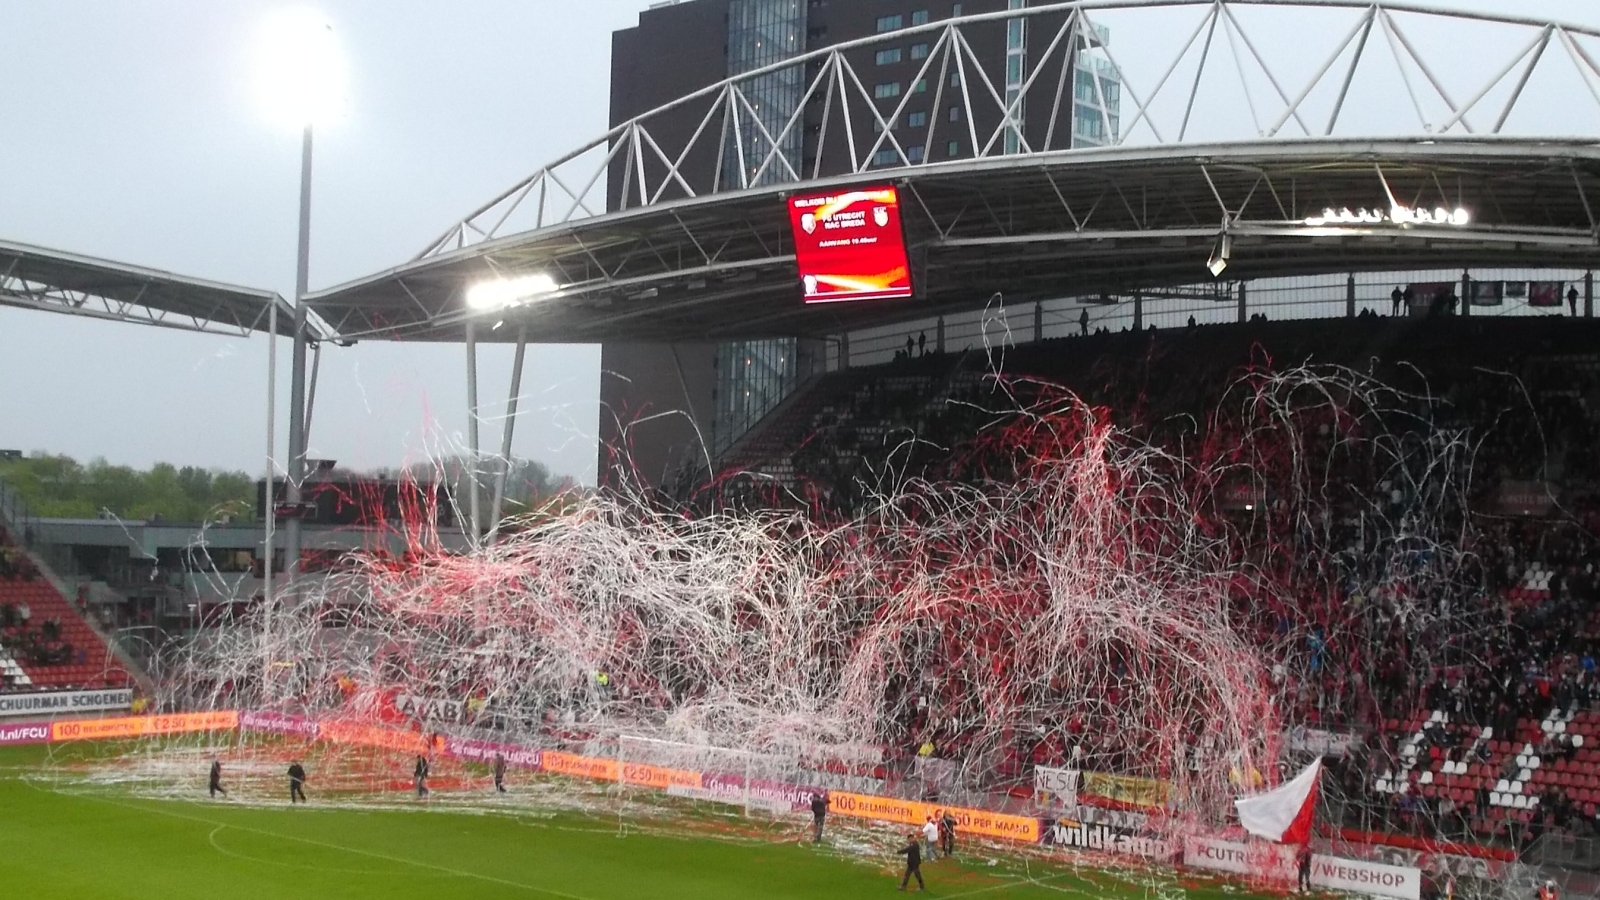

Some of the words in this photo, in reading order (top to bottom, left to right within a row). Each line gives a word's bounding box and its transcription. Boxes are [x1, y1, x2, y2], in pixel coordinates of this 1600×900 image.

[794, 198, 826, 207] WELKOM
[833, 211, 866, 221] UTRECHT
[824, 221, 840, 229] NAC
[841, 219, 866, 228] BREDA
[819, 239, 851, 247] AANVANG
[71, 692, 132, 707] SCHOENEN
[0, 727, 47, 740] l.nl/FCU
[58, 724, 80, 737] 100
[835, 795, 856, 811] 100
[859, 802, 913, 818] BELMINUTEN
[974, 817, 992, 829] PER
[995, 820, 1030, 835] MAAND
[1053, 822, 1172, 861] wildkamp
